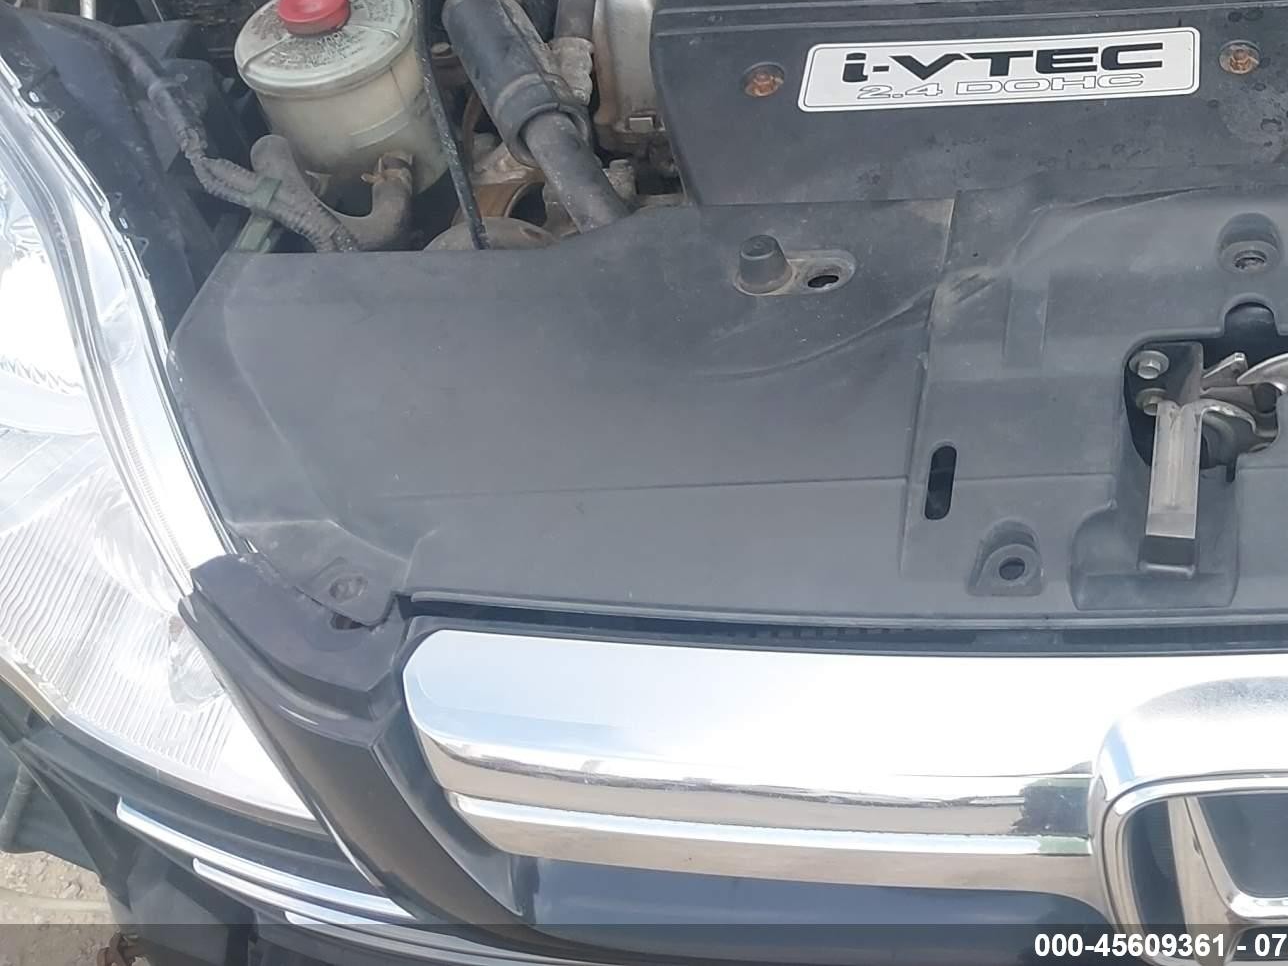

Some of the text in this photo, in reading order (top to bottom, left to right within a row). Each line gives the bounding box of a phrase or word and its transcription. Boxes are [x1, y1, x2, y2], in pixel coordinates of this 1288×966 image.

[842, 42, 1163, 82] i-VTEC
[857, 73, 1144, 100] 2.4 DOHC
